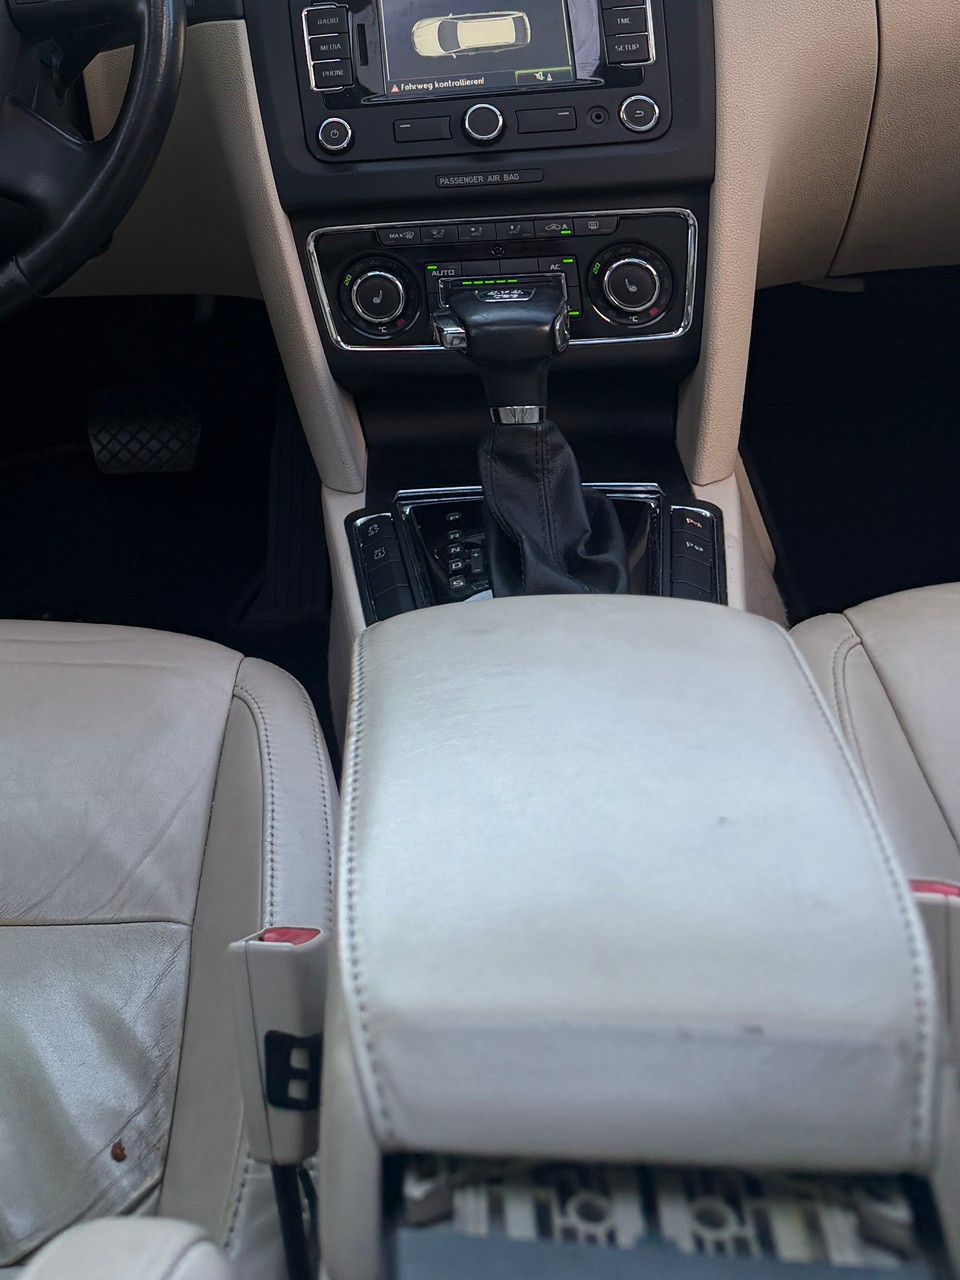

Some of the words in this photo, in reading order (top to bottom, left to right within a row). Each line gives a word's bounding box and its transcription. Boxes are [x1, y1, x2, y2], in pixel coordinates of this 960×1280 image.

[439, 175, 484, 185] PASSENGER
[487, 174, 501, 182] AIR
[503, 173, 520, 181] BAG
